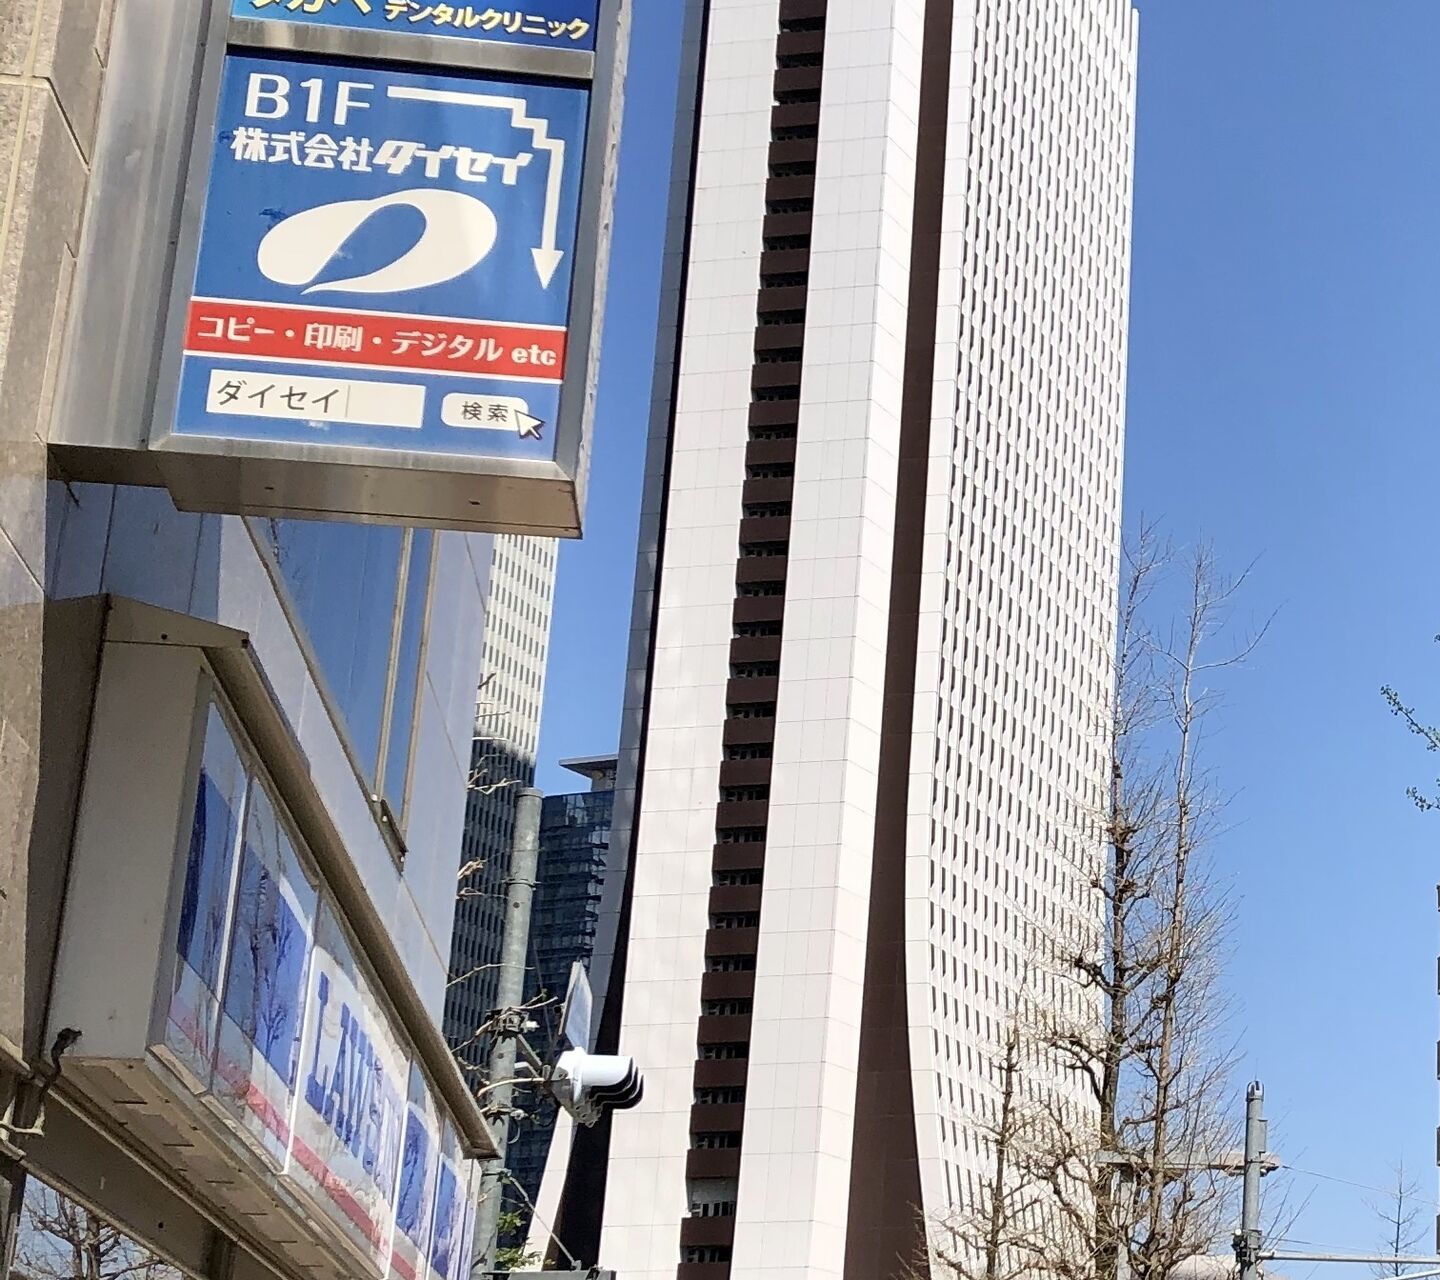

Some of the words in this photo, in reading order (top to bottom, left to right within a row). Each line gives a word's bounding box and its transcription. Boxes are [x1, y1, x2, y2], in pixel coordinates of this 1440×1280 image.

[244, 72, 375, 126] B1F
[230, 126, 533, 186] 株式会社ダイセイ
[511, 344, 557, 366] etc
[216, 379, 341, 415] ダイセイ
[461, 401, 510, 424] 検索
